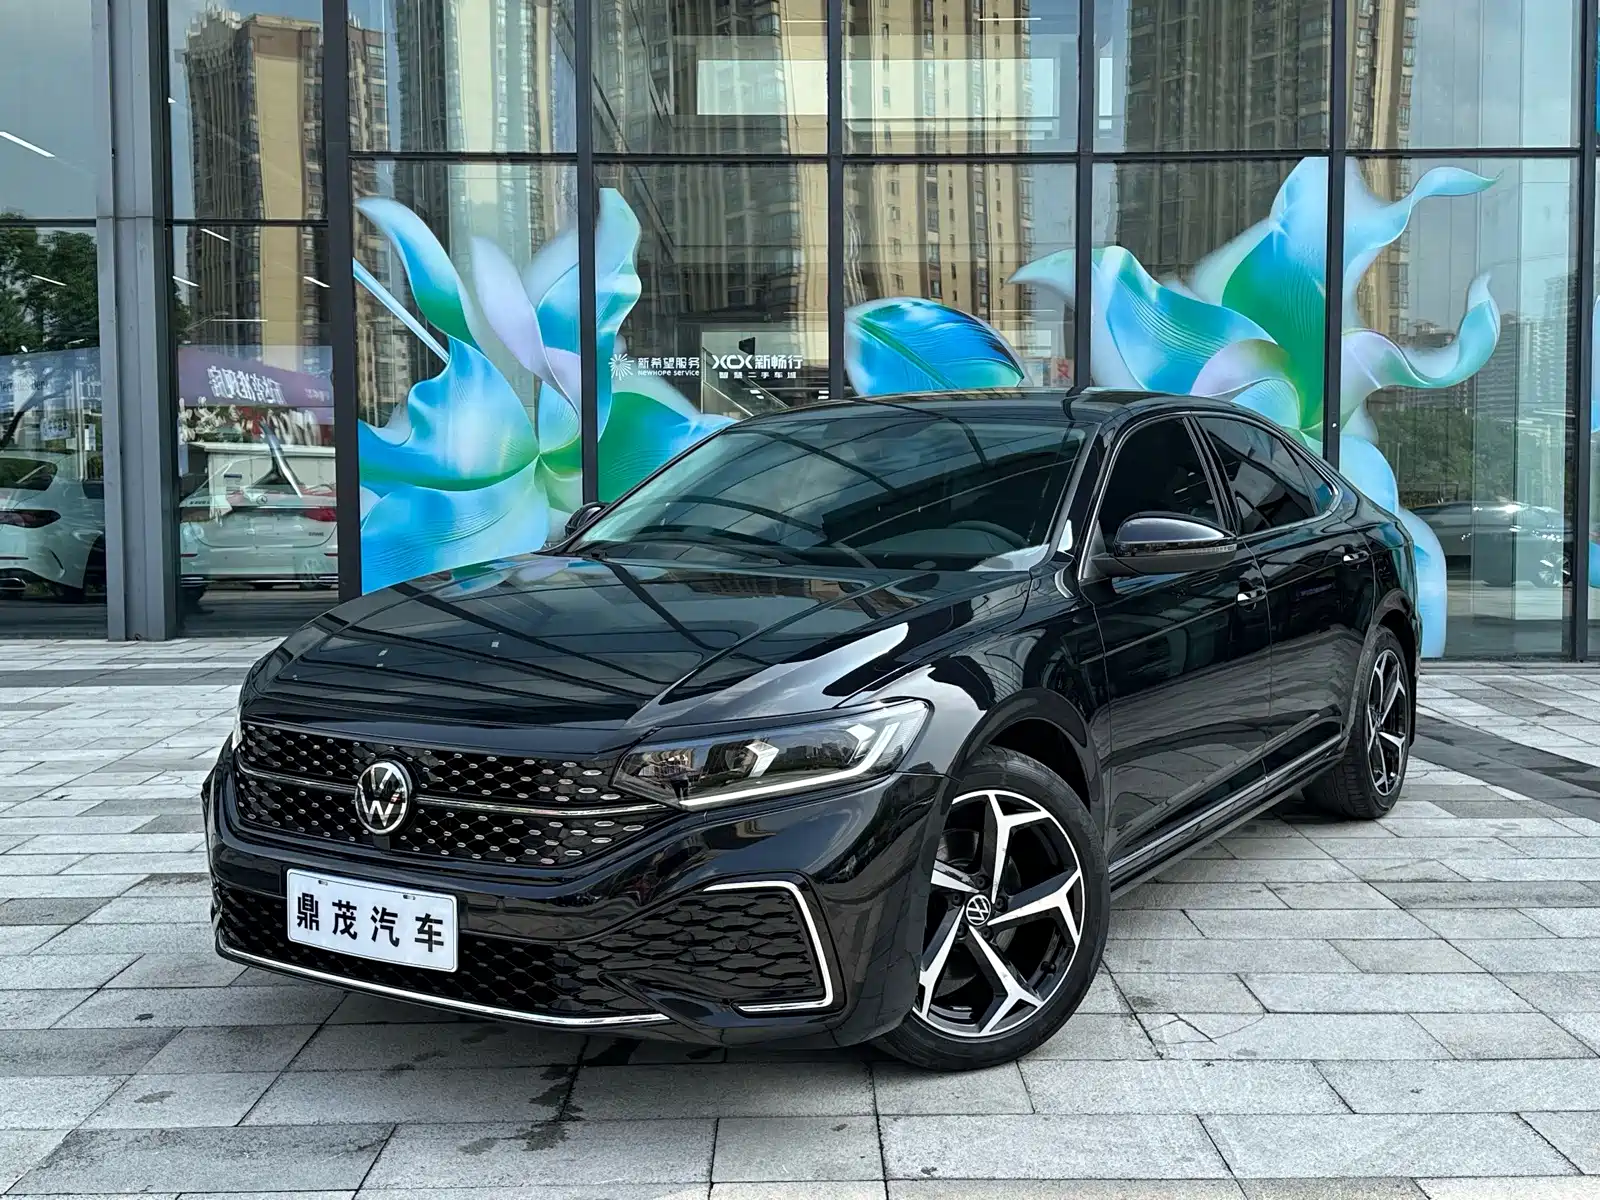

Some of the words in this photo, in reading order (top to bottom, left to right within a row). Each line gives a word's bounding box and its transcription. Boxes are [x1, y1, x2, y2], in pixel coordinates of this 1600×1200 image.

[637, 357, 700, 369] 新希望服务
[296, 892, 445, 953] 鼎茂汽车
